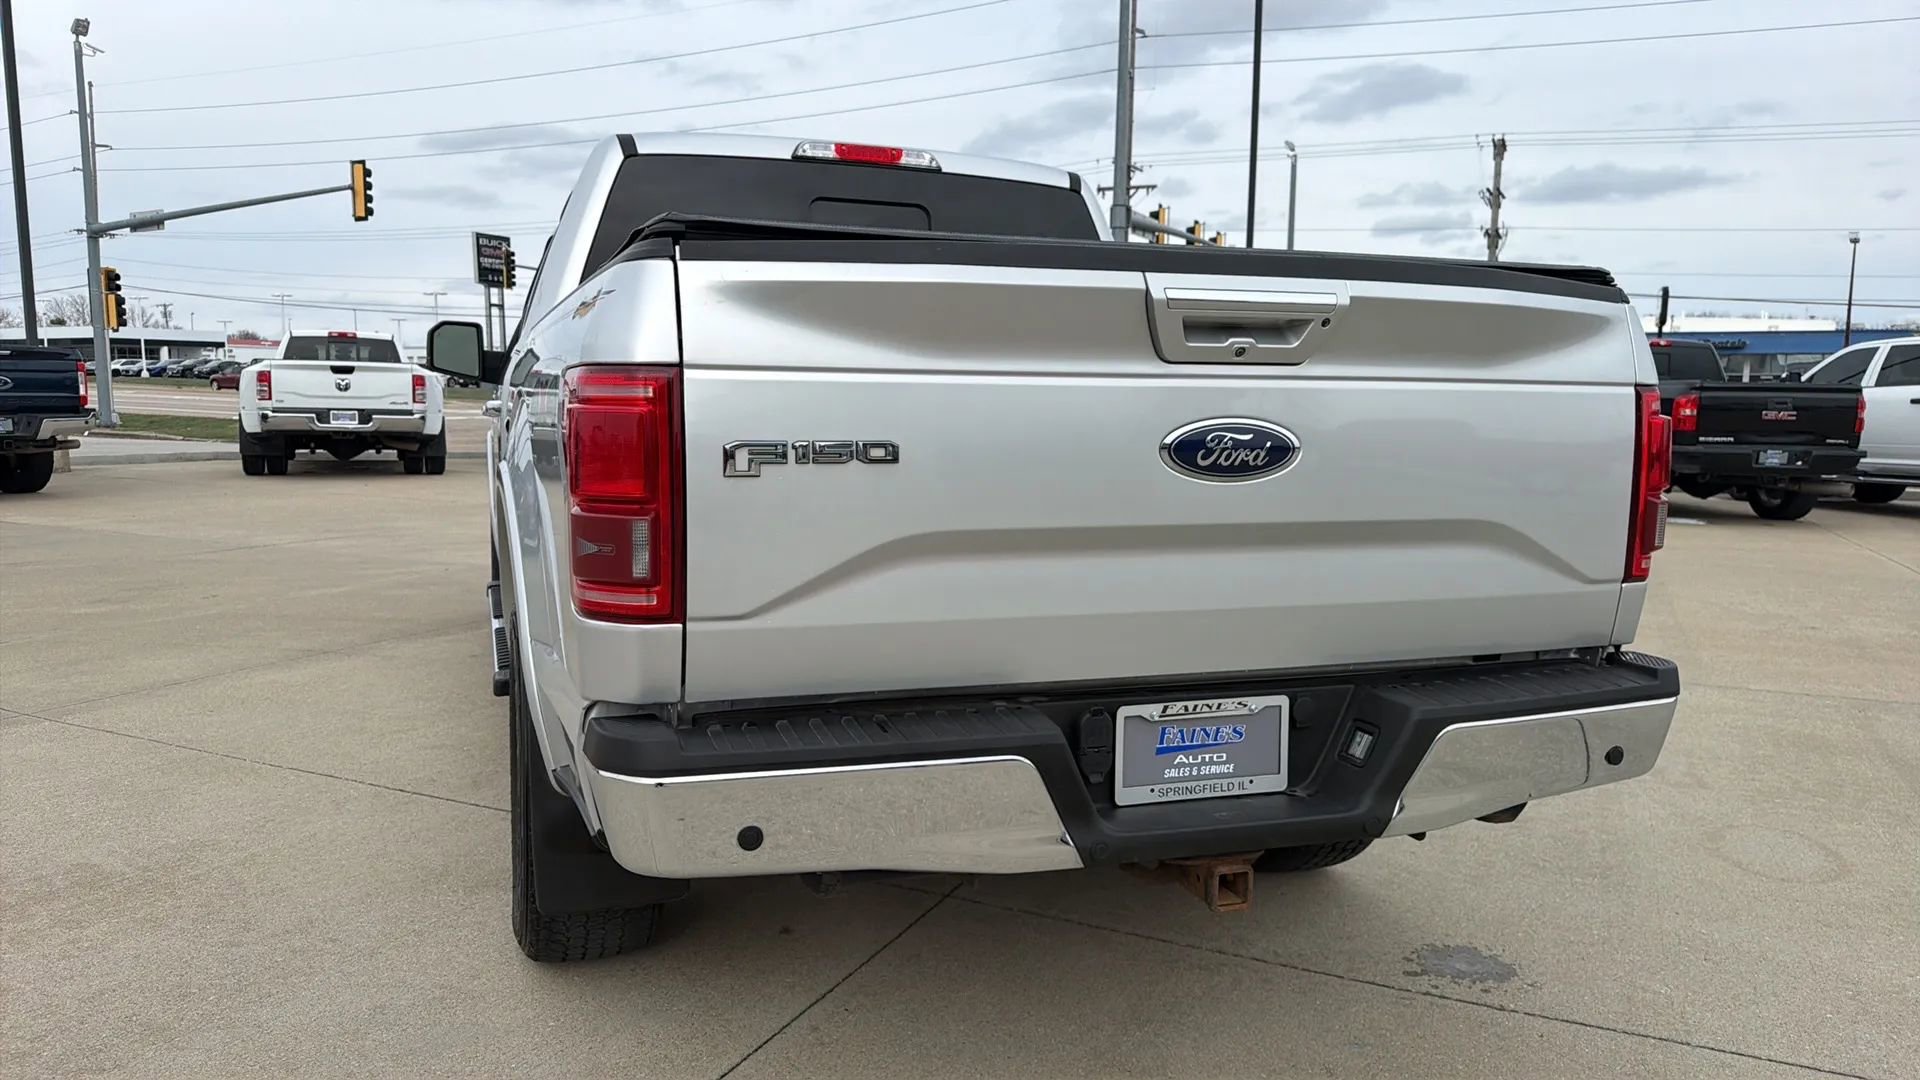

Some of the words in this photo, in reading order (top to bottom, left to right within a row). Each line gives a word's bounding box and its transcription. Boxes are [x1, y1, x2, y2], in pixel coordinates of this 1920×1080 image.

[1762, 410, 1797, 420] GMC
[1196, 431, 1272, 467] Ford
[1160, 700, 1249, 715] FAINE'S
[1156, 723, 1247, 748] FAINE'S
[1173, 752, 1227, 764] AUTO
[1163, 767, 1190, 778] SALES
[1191, 765, 1198, 775] &
[1199, 763, 1235, 775] SERVICE
[1157, 781, 1235, 799] SPRINGFIELD
[1237, 780, 1248, 792] IL
